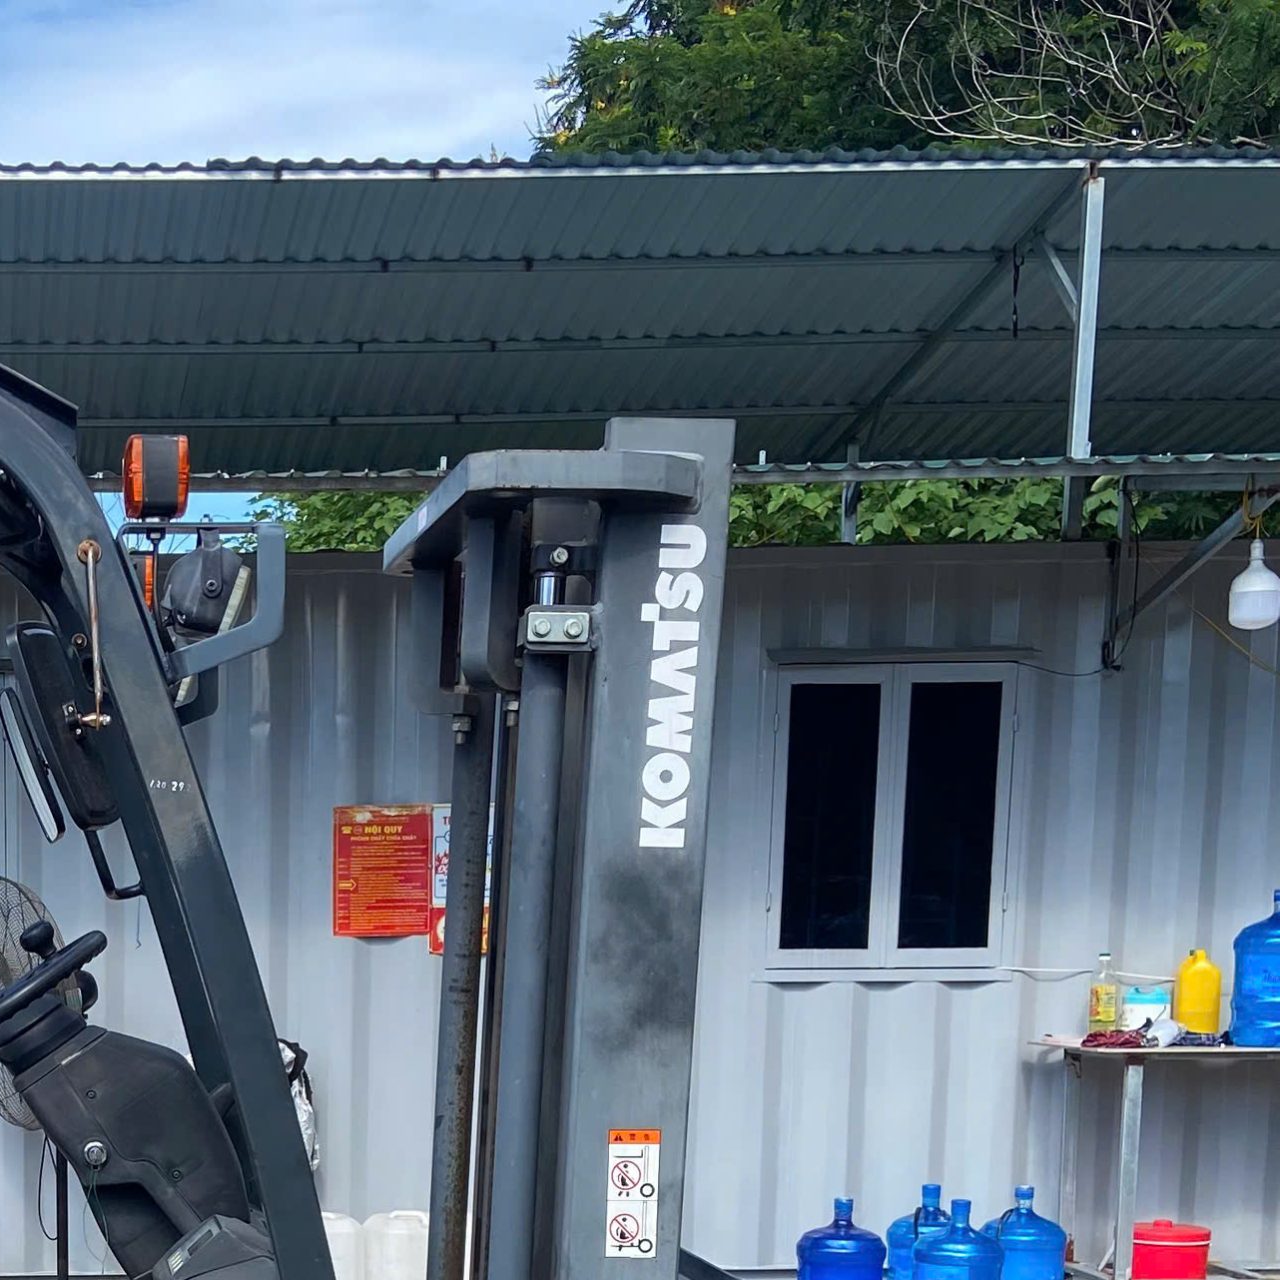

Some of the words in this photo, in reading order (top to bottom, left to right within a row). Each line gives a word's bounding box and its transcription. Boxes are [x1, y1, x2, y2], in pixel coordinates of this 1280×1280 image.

[639, 523, 708, 849] KOMATSU
[364, 824, 382, 835] NỘI
[384, 825, 403, 835] QUY
